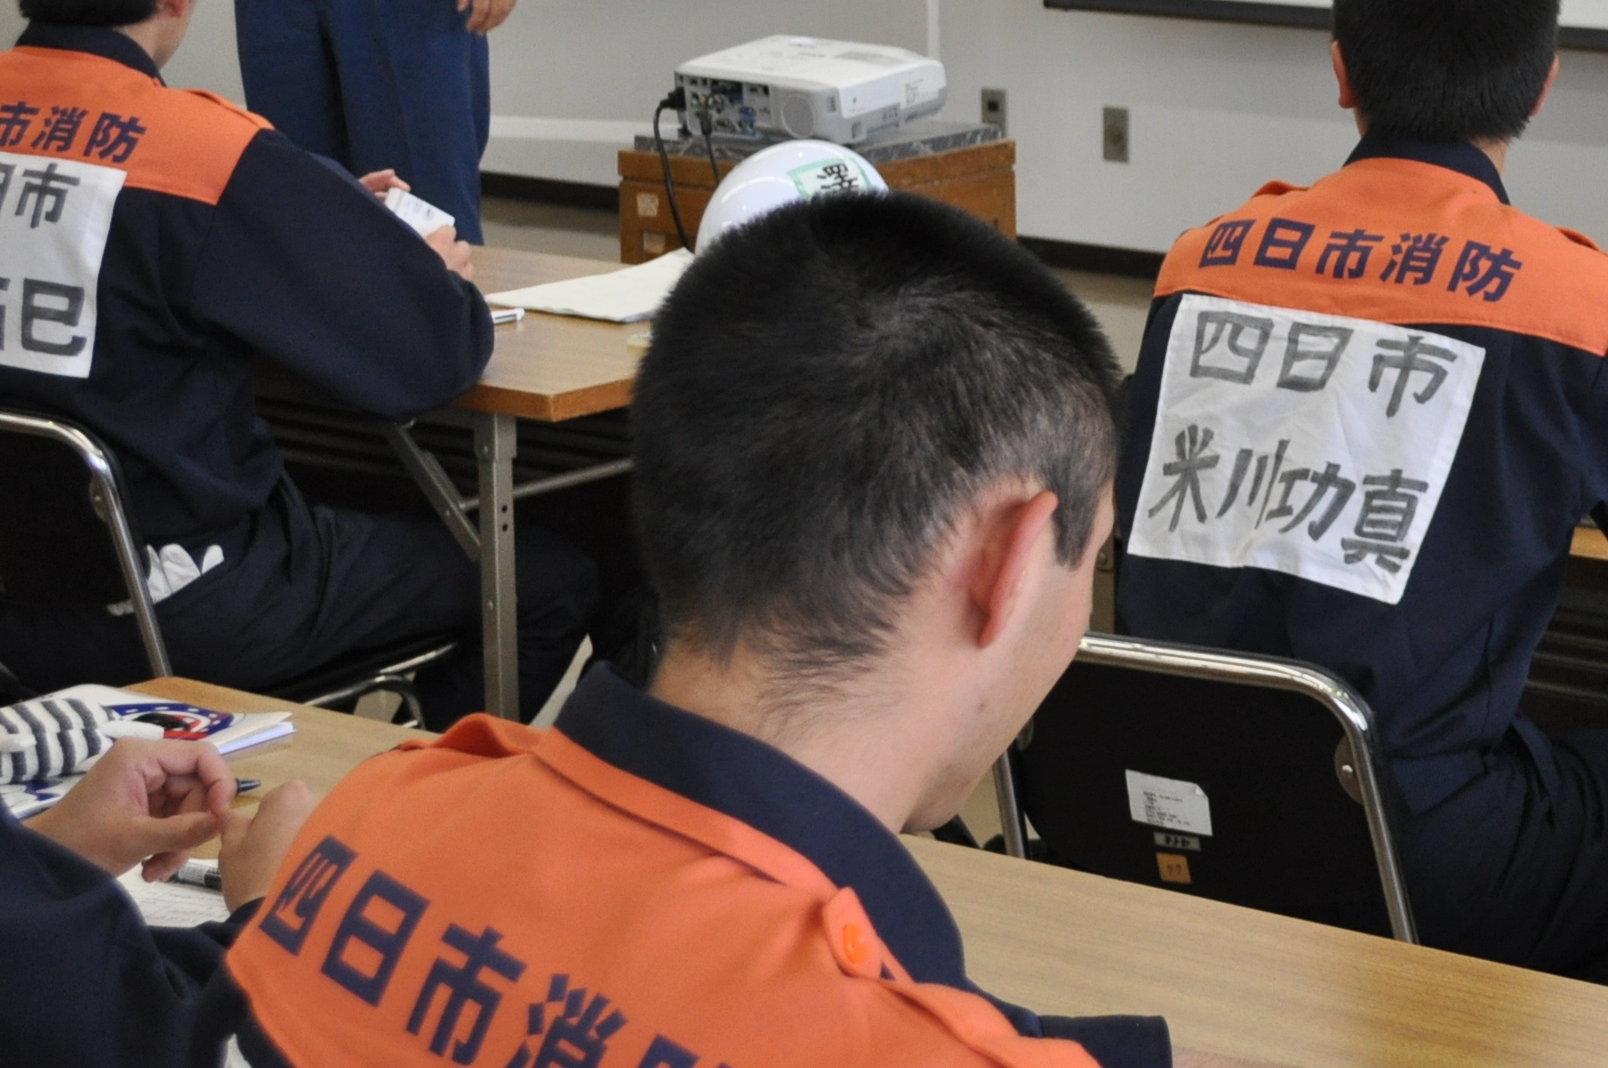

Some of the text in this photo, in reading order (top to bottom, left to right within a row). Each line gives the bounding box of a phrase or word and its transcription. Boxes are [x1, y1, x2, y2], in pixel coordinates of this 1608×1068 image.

[0, 162, 81, 229] 市
[1198, 216, 1523, 302] 四日市消防
[0, 276, 88, 357] 巳
[1189, 310, 1459, 419] 四日市
[258, 835, 735, 1068] 四日市消
